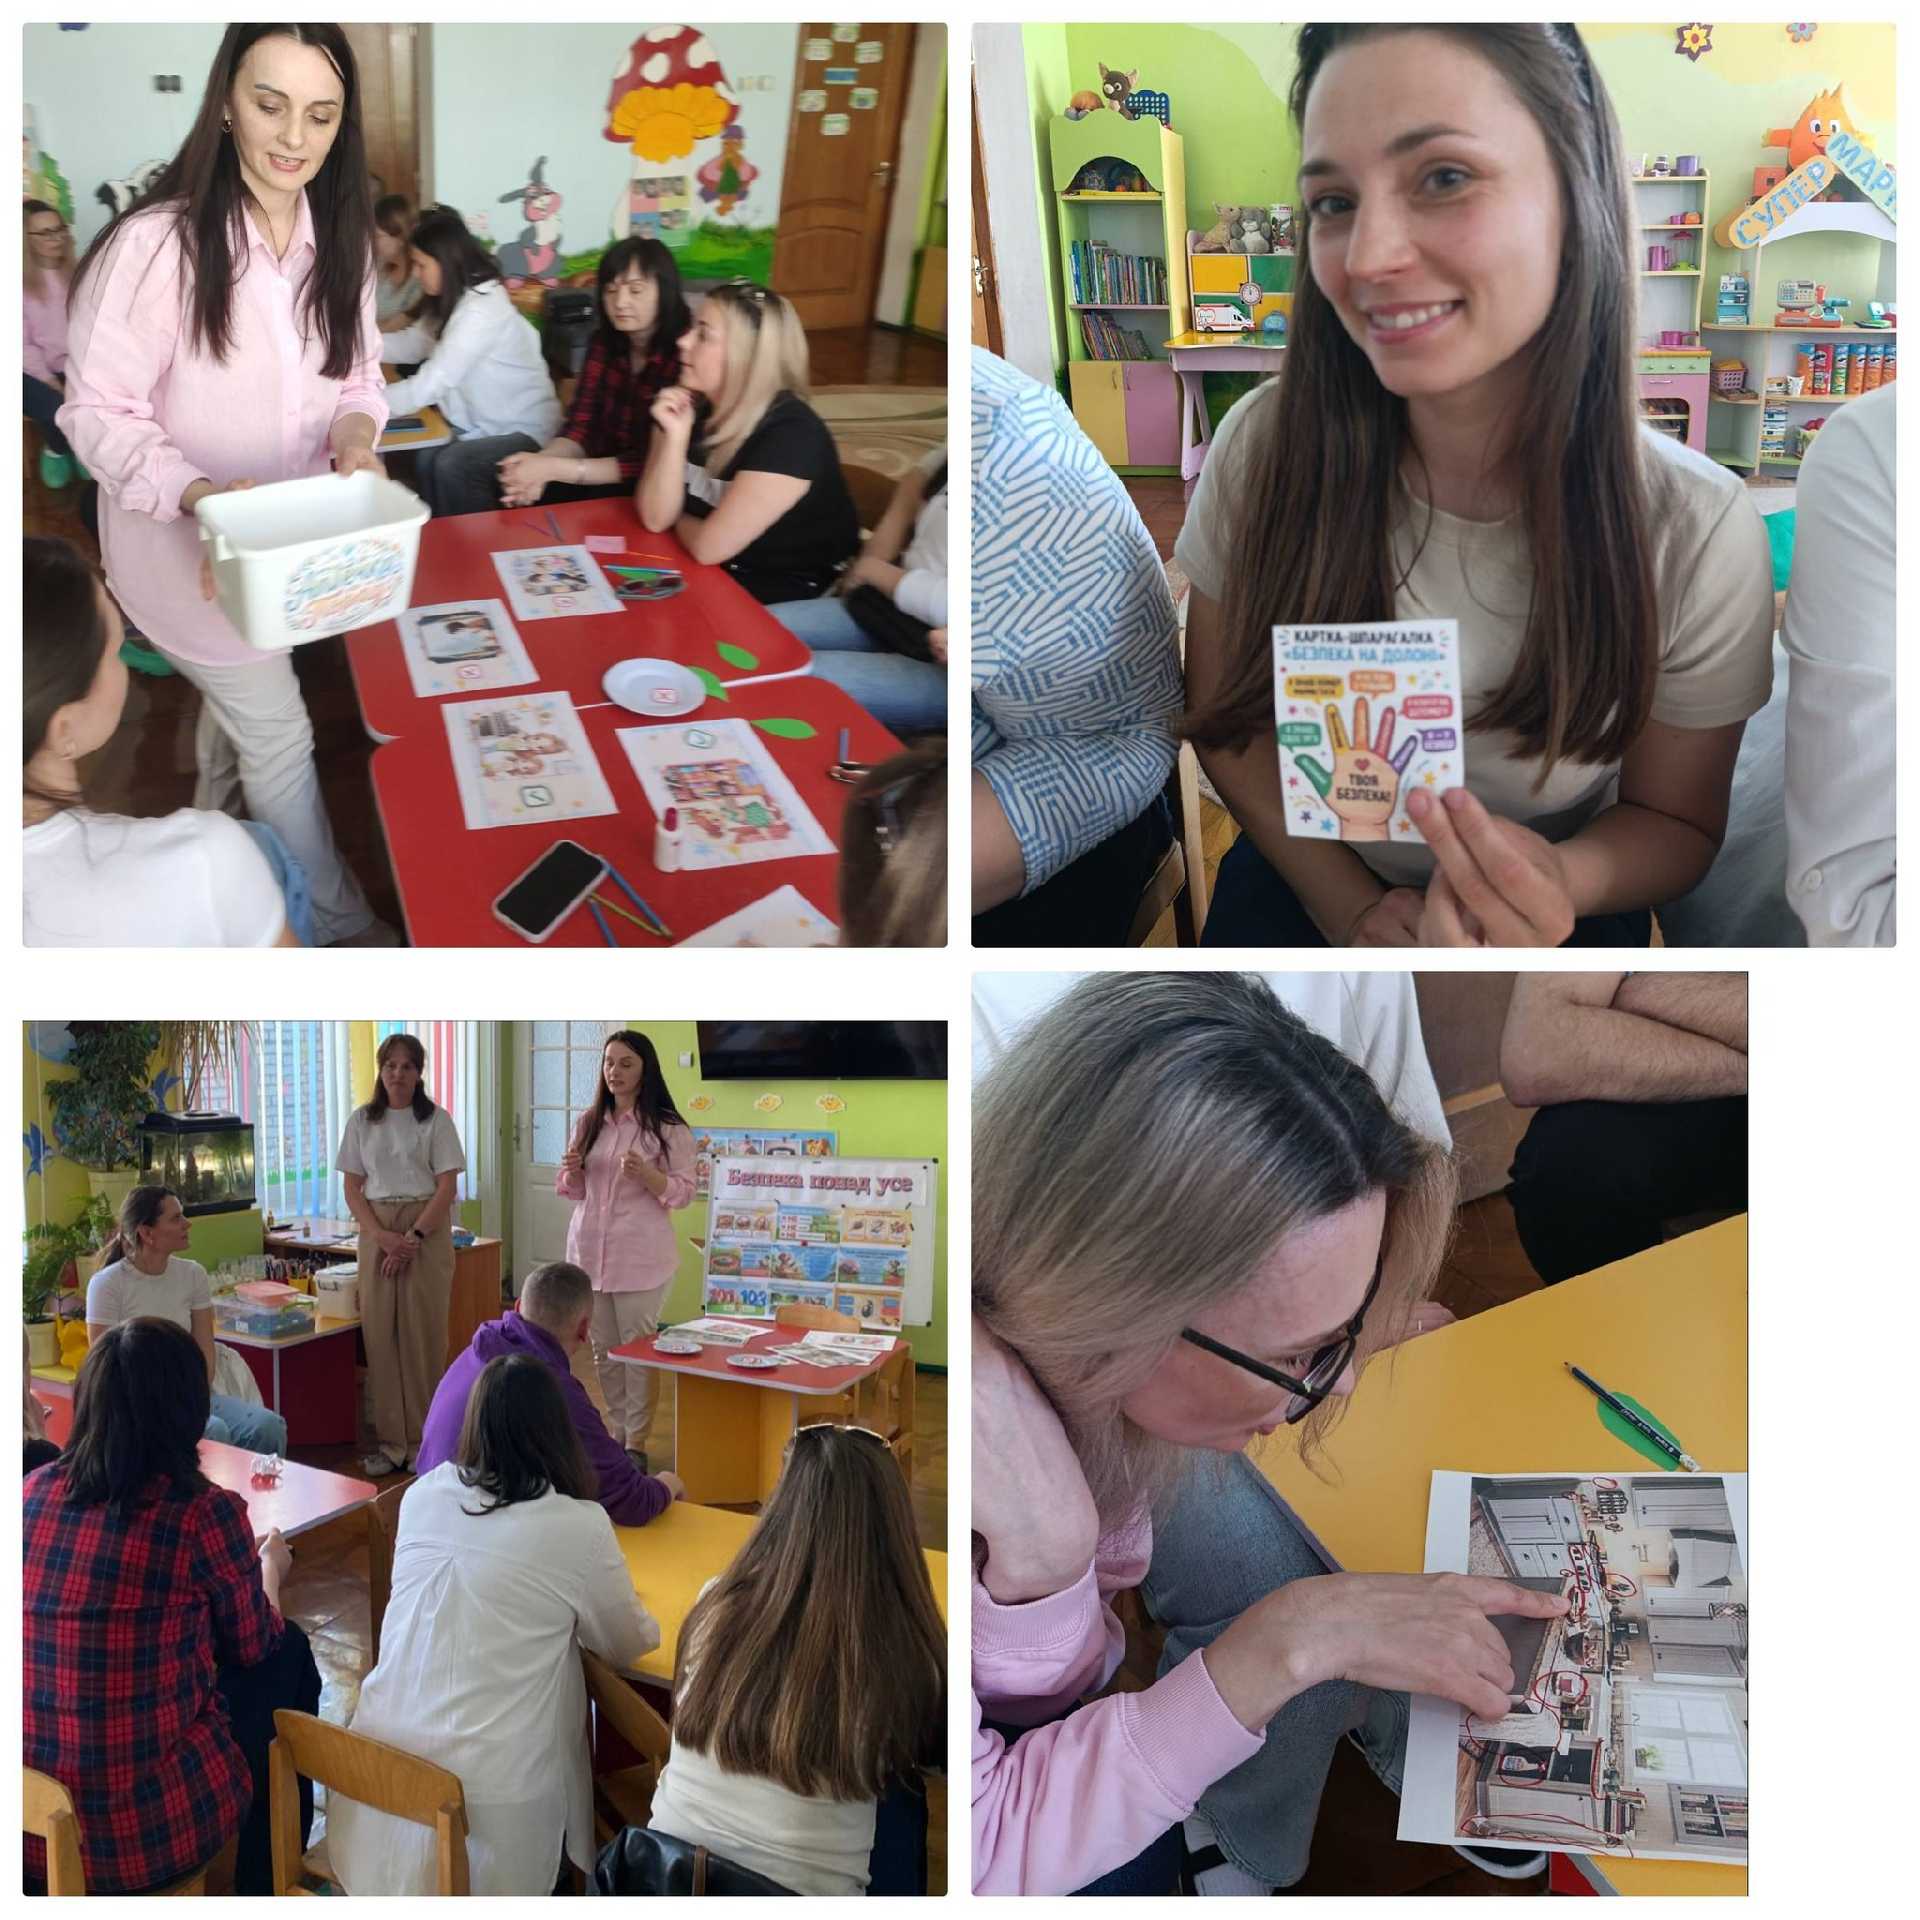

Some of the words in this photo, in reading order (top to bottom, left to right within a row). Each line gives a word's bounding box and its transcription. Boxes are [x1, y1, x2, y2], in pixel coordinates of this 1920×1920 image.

[1736, 160, 1827, 246] СУПЕР
[1294, 629, 1434, 645] КАРТКА-ШПАРАГАЛКА
[1359, 647, 1377, 661] НА
[1349, 773, 1379, 786] ТВОЯ
[1336, 787, 1391, 802] БЕЗПЕКА!
[727, 1168, 804, 1189] Безпека
[809, 1175, 871, 1196] понад
[876, 1176, 913, 1197] усе
